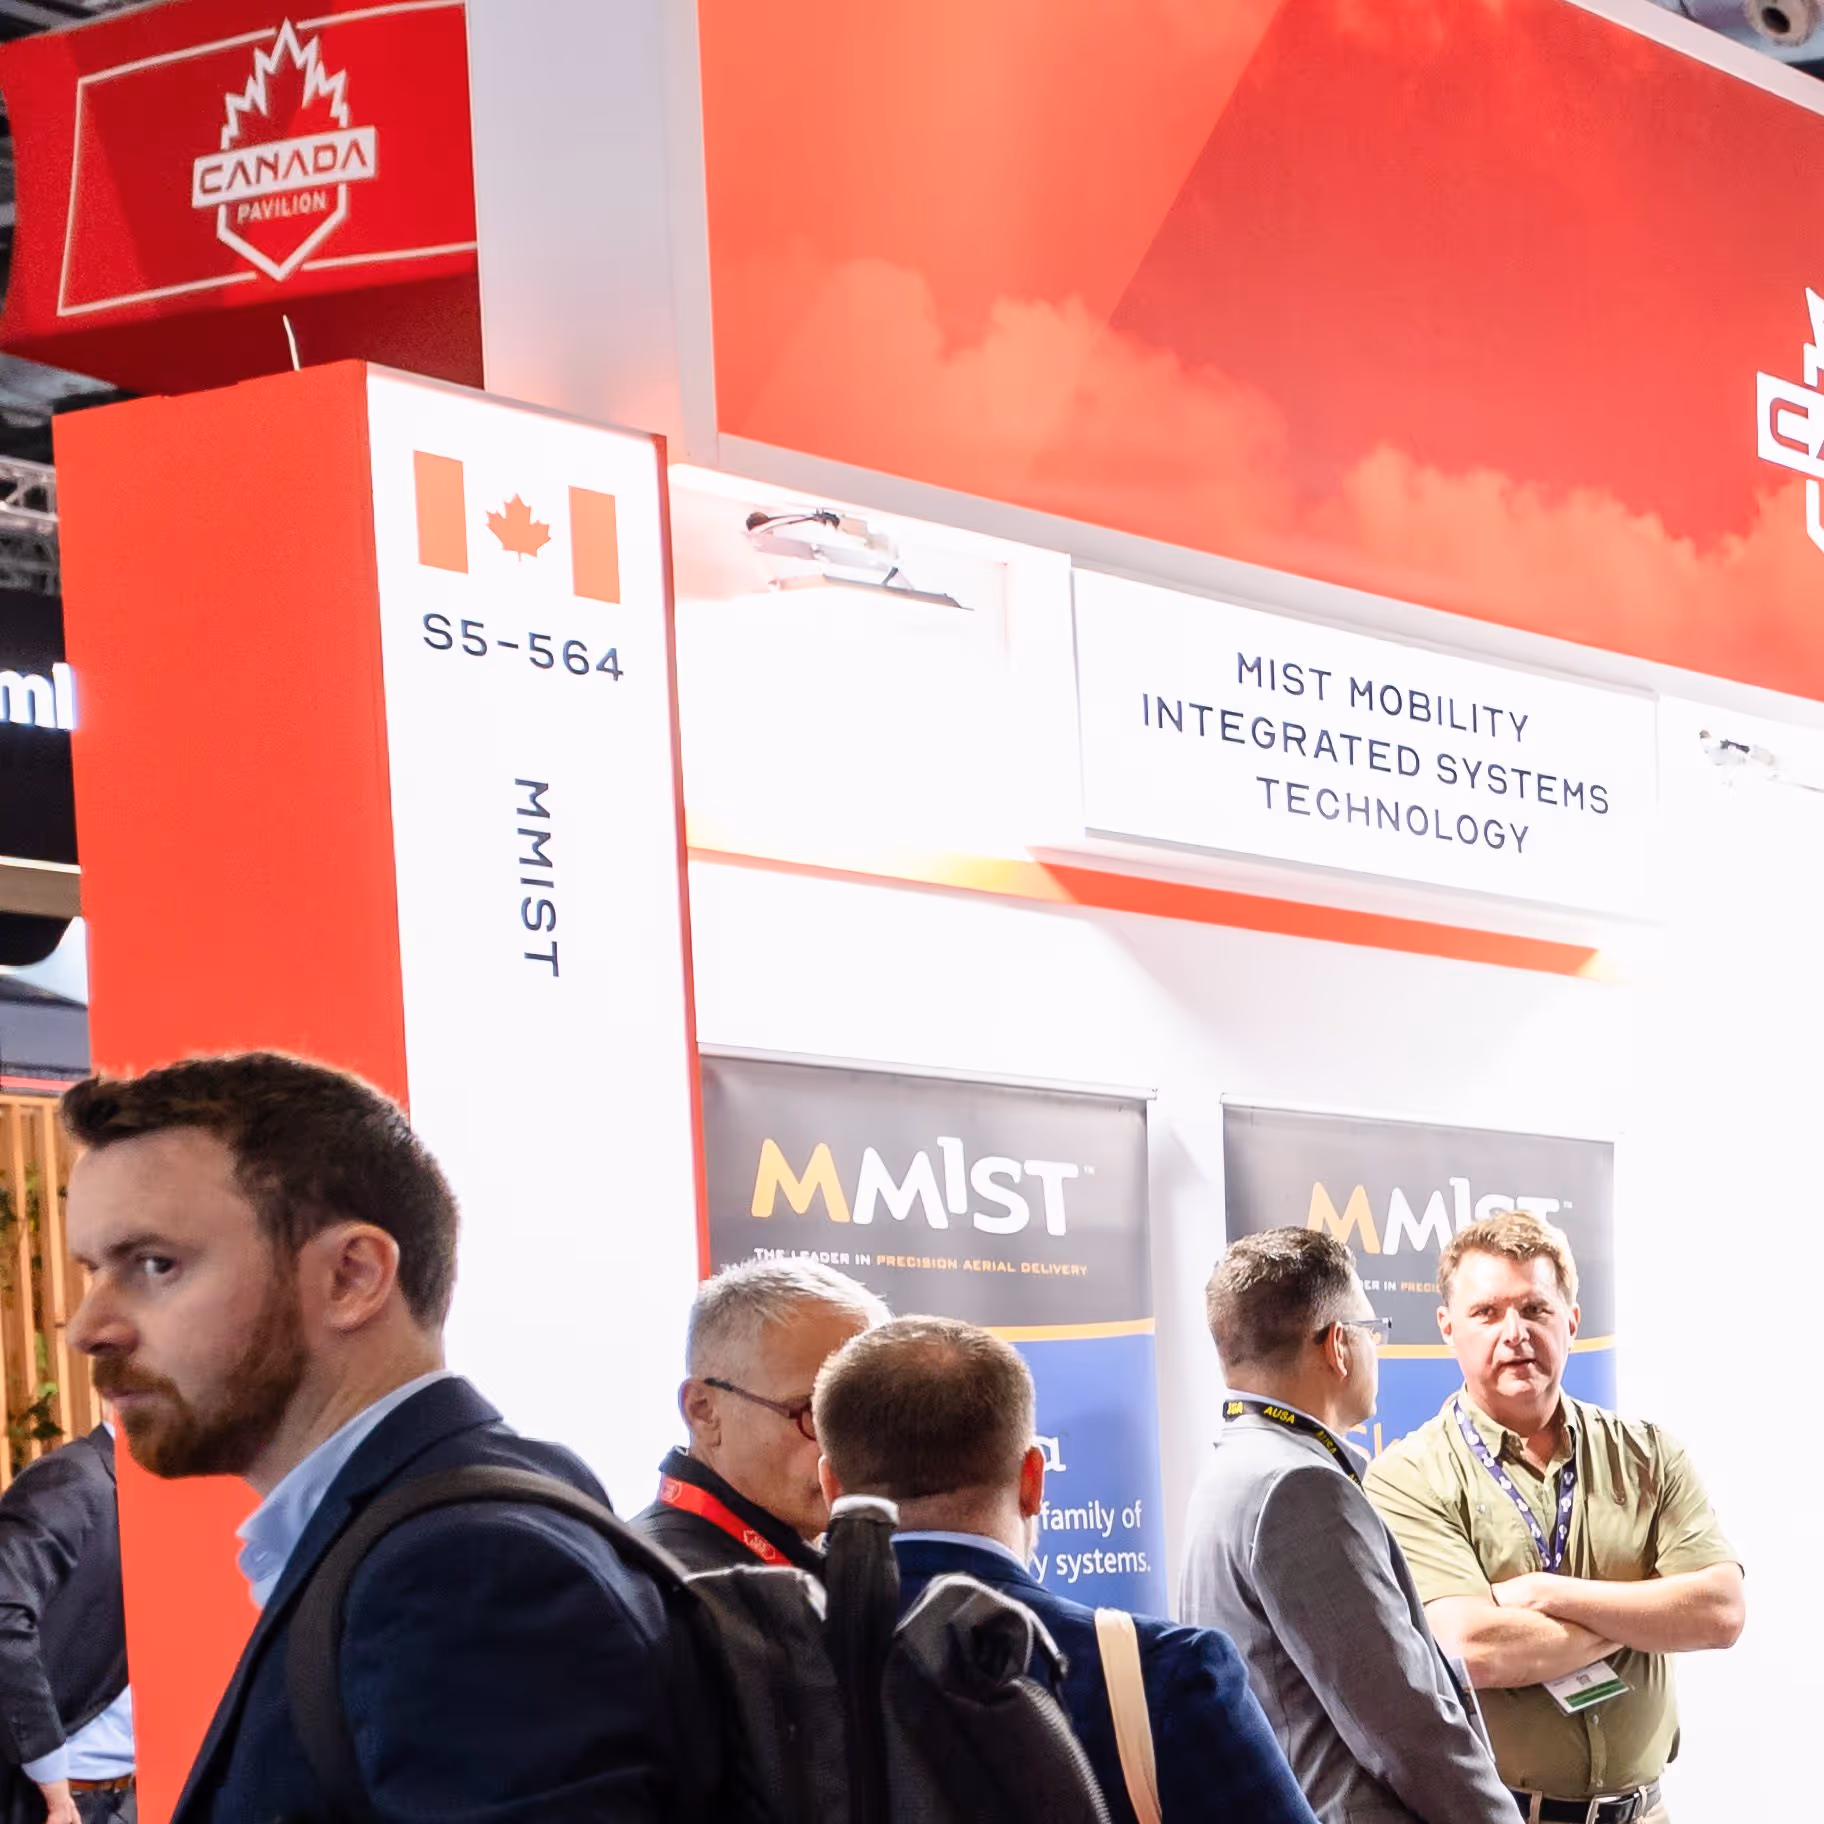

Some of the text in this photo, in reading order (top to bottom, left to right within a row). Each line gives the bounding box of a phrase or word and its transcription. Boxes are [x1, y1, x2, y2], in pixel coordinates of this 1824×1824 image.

[199, 134, 370, 196] CANADA
[236, 190, 328, 224] PAVILION
[422, 612, 625, 683] S5-564
[1236, 651, 1529, 743] MIST MOBILITY
[1141, 692, 1610, 815] INTEGRATED SYSTEMS
[1256, 776, 1529, 855] TECHNOLOGY
[514, 777, 560, 978] MMIST
[855, 1253, 871, 1265] IN
[876, 1254, 957, 1271] PRECISION
[963, 1258, 1016, 1273] AERIAL
[1020, 1260, 1088, 1277] DELIVERY
[1263, 1406, 1296, 1425] AUSA
[1041, 1499, 1143, 1538] family of
[1055, 1548, 1152, 1584] systems.
